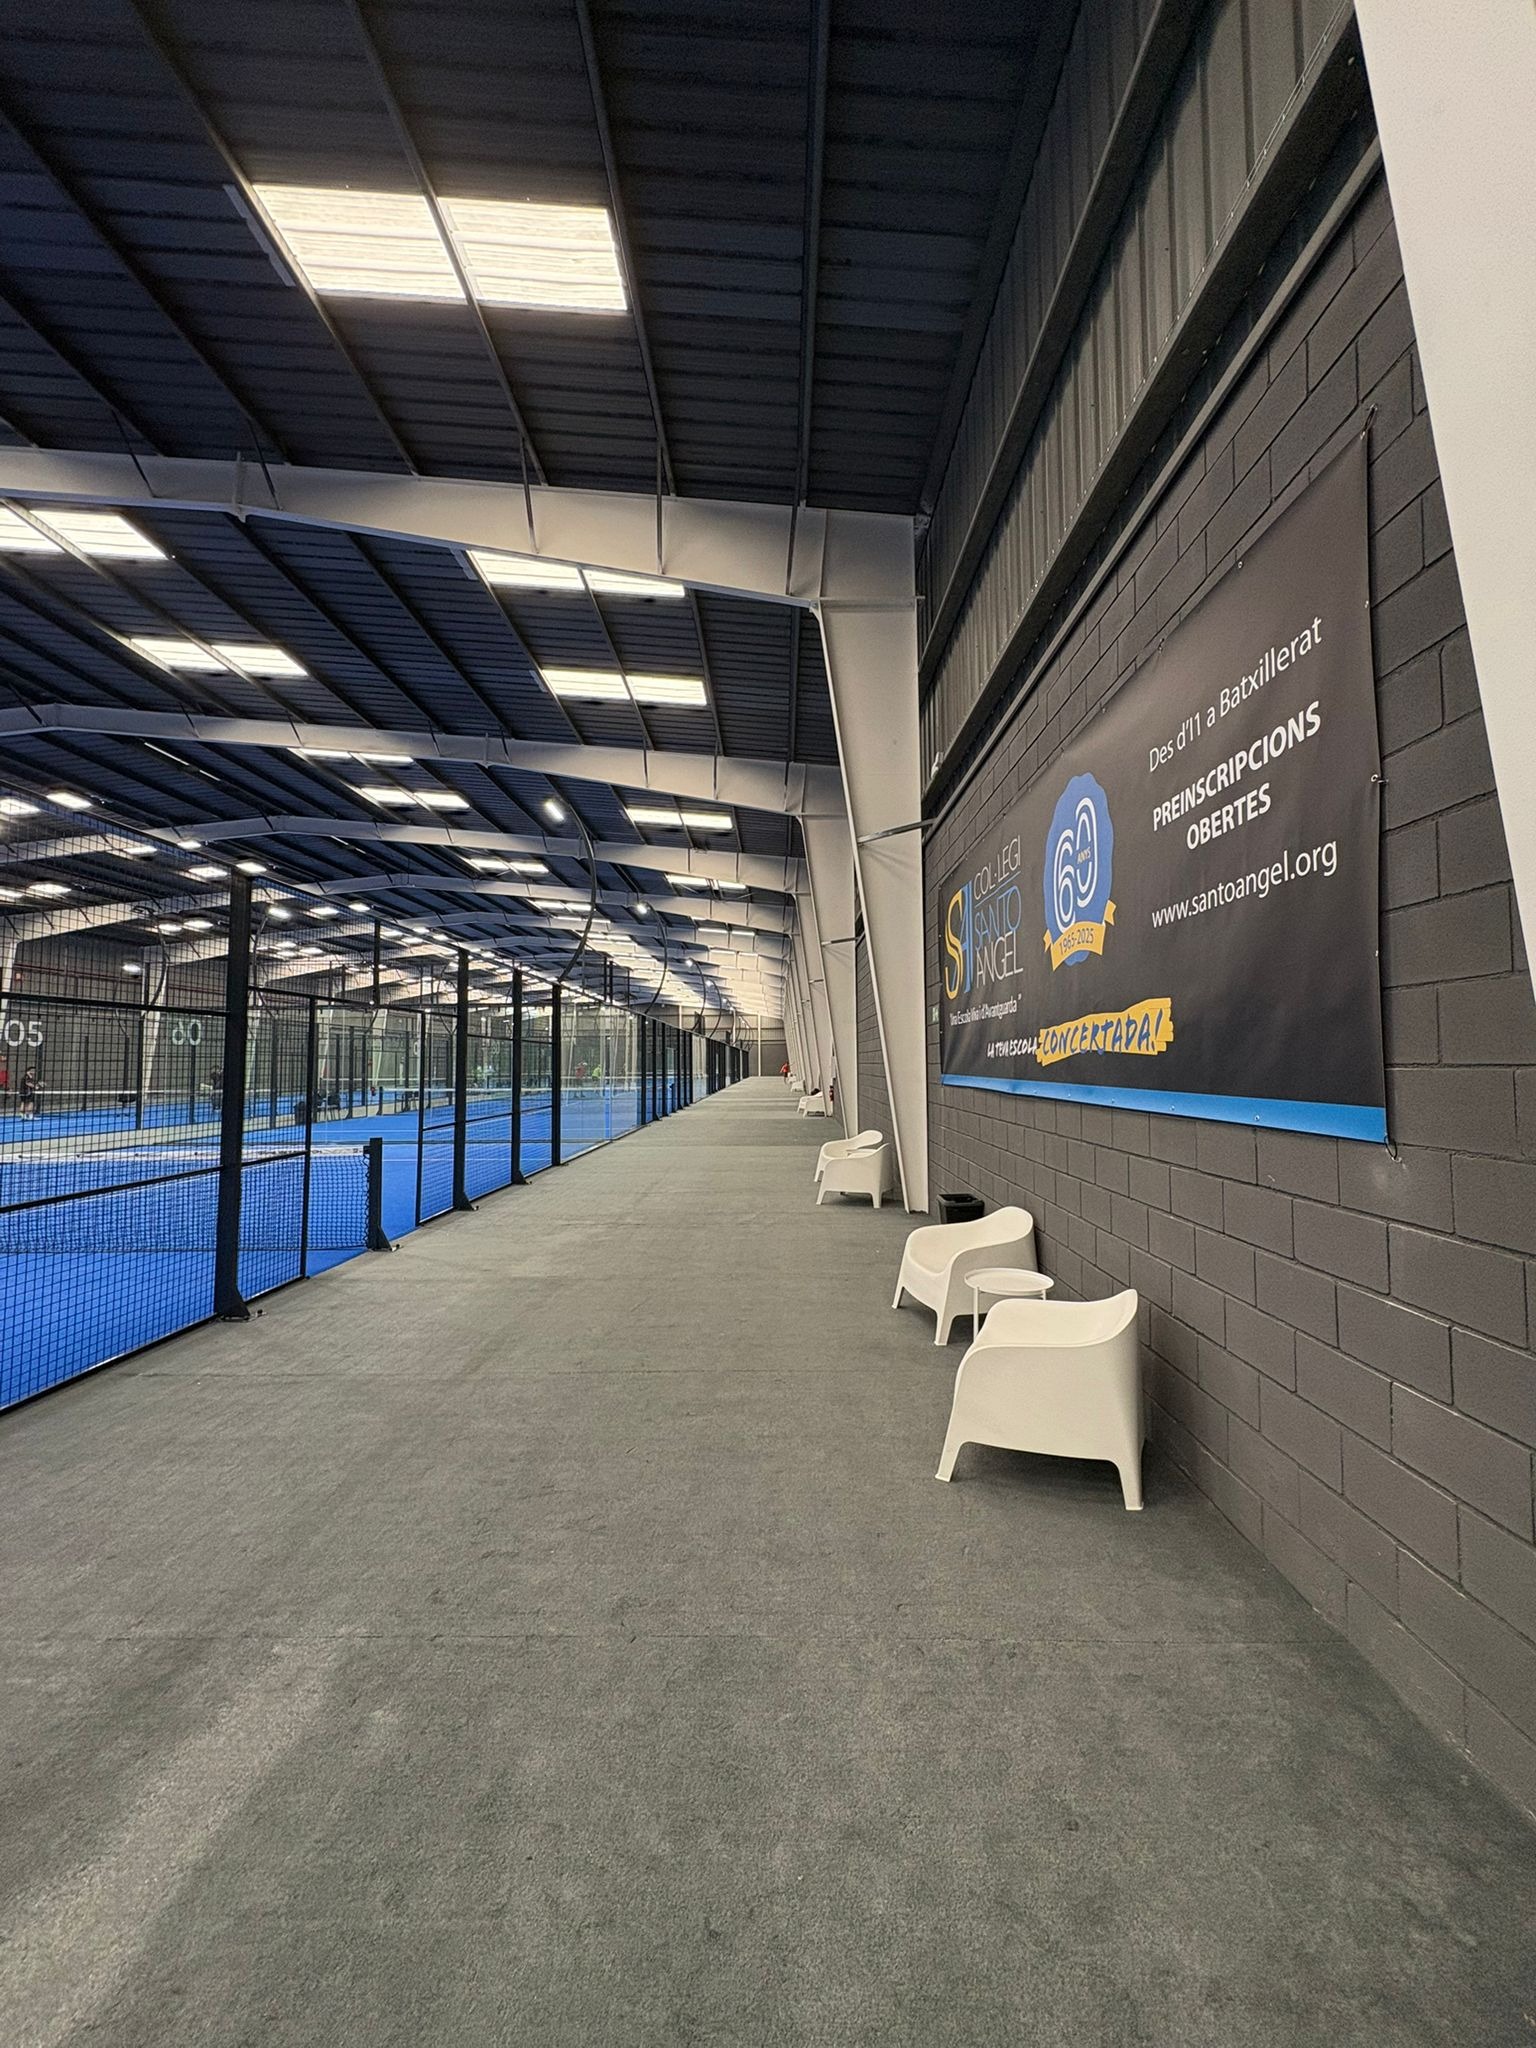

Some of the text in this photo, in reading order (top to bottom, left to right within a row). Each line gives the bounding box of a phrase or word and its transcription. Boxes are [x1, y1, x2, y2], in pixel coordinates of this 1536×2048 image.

[1149, 738, 1174, 772] Des
[1205, 706, 1217, 728] a
[1219, 616, 1323, 718] Batxillerat
[1152, 700, 1322, 832] PREINSCRIPCIONS
[1186, 782, 1272, 850] OBERTES
[1053, 797, 1098, 934] 60
[1151, 840, 1339, 928] www.santoangel.org
[974, 885, 1022, 951] SANTO
[1058, 928, 1095, 956] 1965-2025
[976, 930, 1024, 988] ANGEL
[4, 1020, 43, 1047] 05
[1009, 1036, 1037, 1056] ESCOLA
[1042, 1008, 1163, 1056] CONCERTADA!
